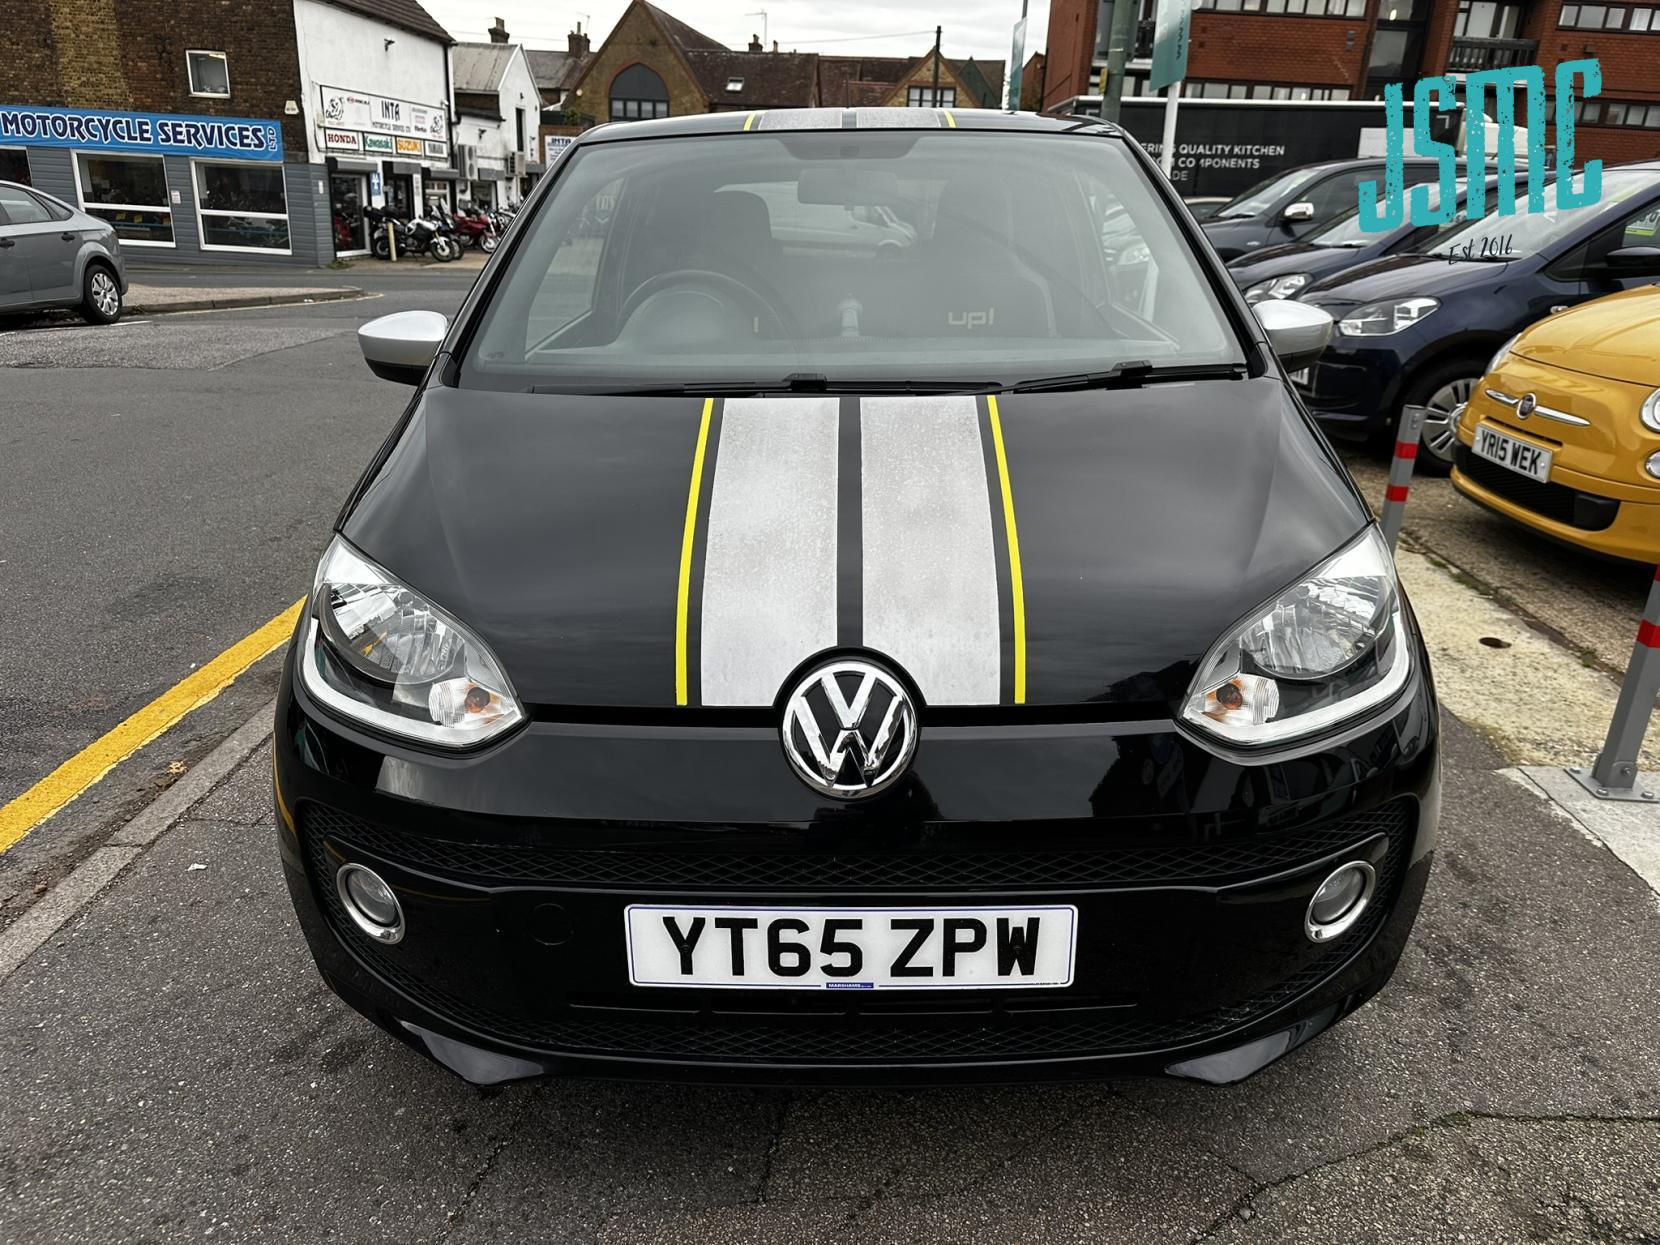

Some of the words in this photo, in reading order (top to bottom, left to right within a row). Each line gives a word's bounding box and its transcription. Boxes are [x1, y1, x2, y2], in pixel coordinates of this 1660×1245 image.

[381, 100, 400, 121] INTA
[1, 112, 152, 143] MOTORCYCLE
[158, 120, 266, 149] SERVICES
[267, 127, 277, 151] LTD
[328, 133, 357, 145] HONDA
[364, 135, 392, 150] Kawasaki
[397, 139, 422, 154] SUZUKI
[1179, 143, 1231, 155] QUALITY
[1233, 145, 1285, 156] KITCHEN
[948, 307, 994, 330] up!
[1481, 430, 1509, 462] YR15
[1510, 443, 1542, 475] WEK
[662, 916, 864, 977] YT65
[889, 917, 1041, 977] ZPW
